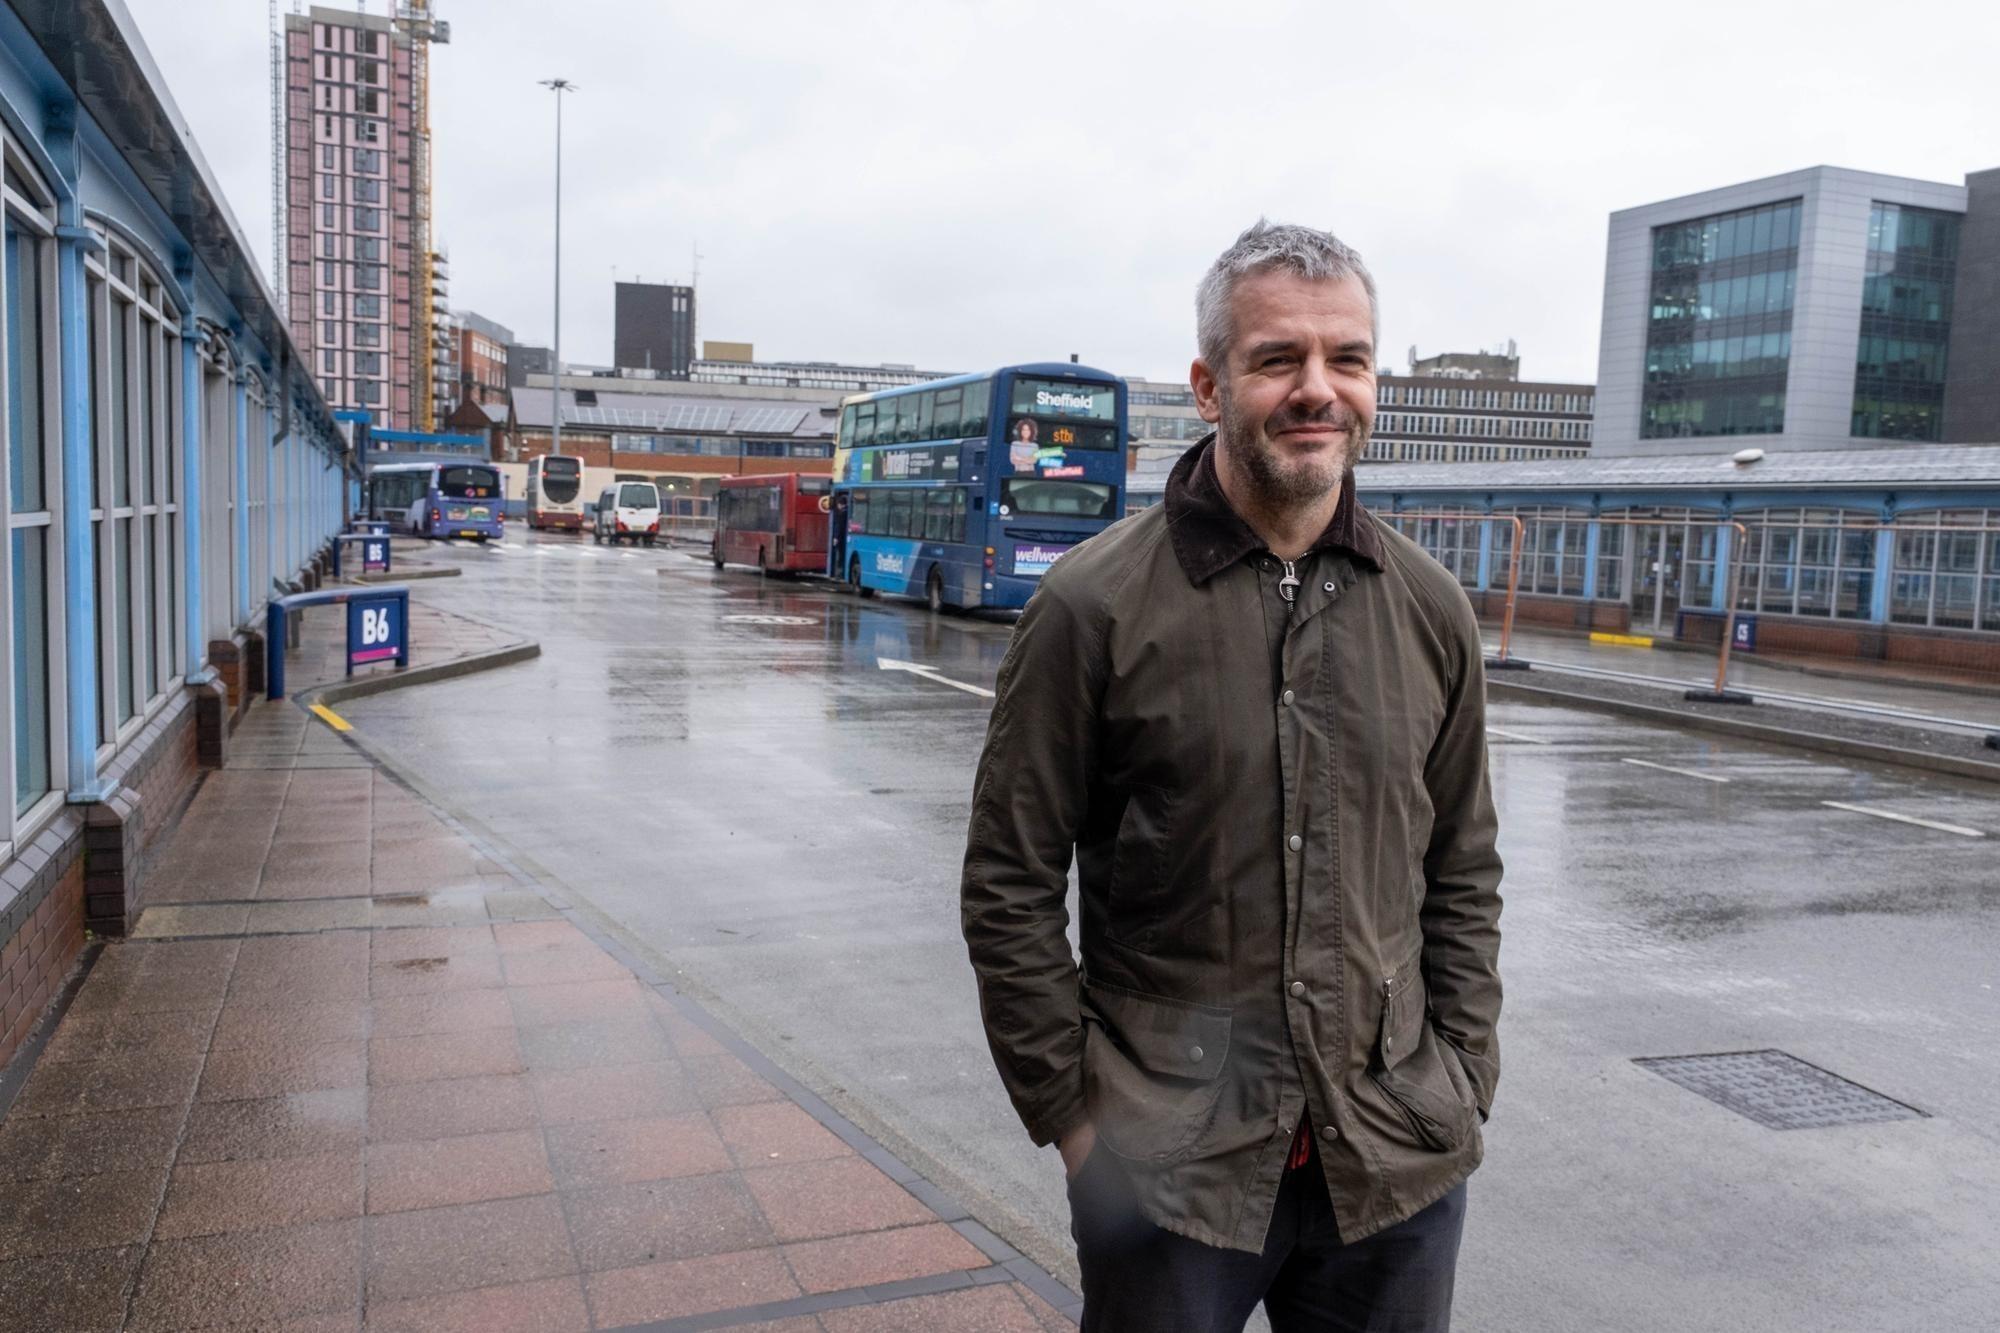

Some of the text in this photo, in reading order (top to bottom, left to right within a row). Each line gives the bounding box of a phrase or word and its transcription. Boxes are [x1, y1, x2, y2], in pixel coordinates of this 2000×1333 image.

[1036, 391, 1093, 409] Sheffield
[369, 543, 383, 561] B5
[362, 607, 390, 645] B6
